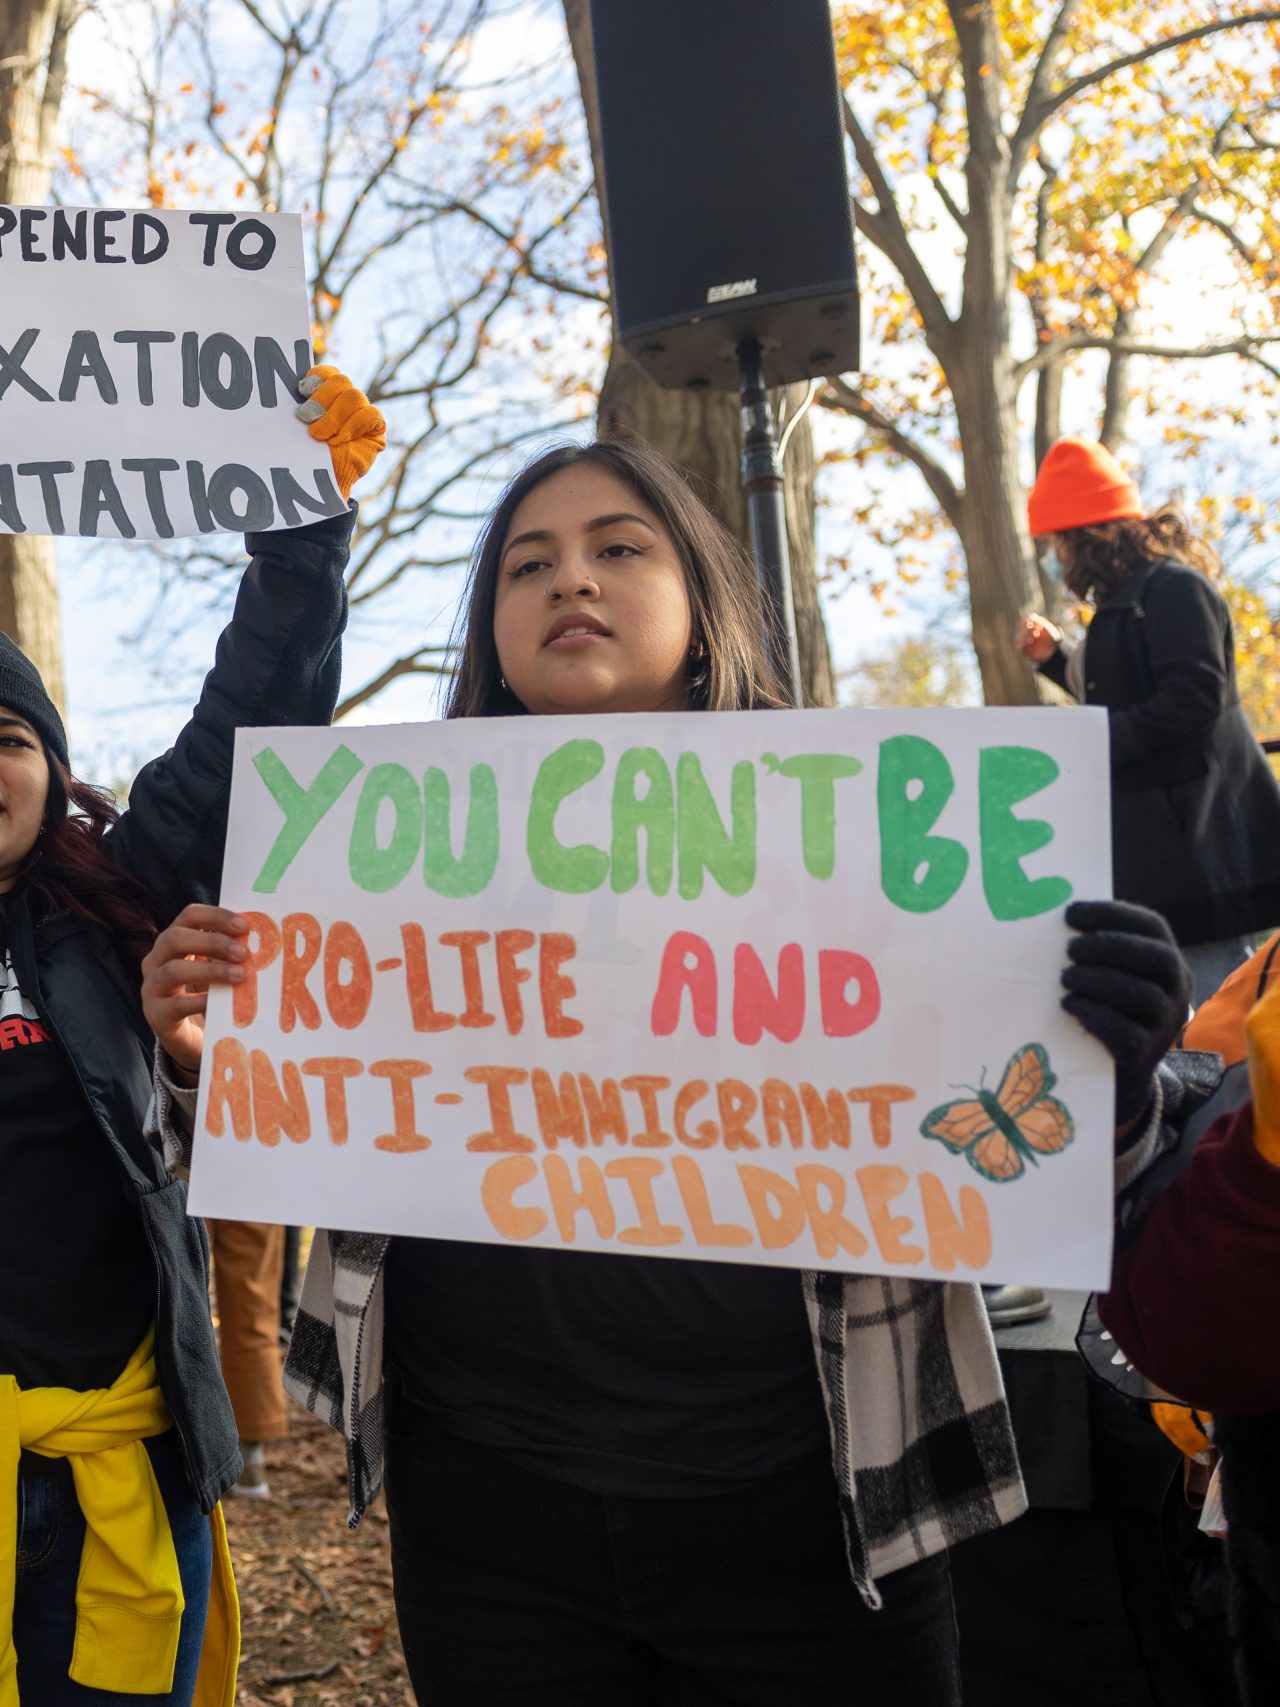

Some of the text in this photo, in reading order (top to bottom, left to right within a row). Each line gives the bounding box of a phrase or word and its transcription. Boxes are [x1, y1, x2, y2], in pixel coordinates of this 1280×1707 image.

[189, 212, 276, 270] TO
[252, 734, 1073, 922] YOU CAN'T BE
[231, 911, 880, 1046] PRO-LIFE AND
[204, 1037, 916, 1154] ANTI-IMMIGRANT
[482, 1154, 992, 1272] CHILDREN
